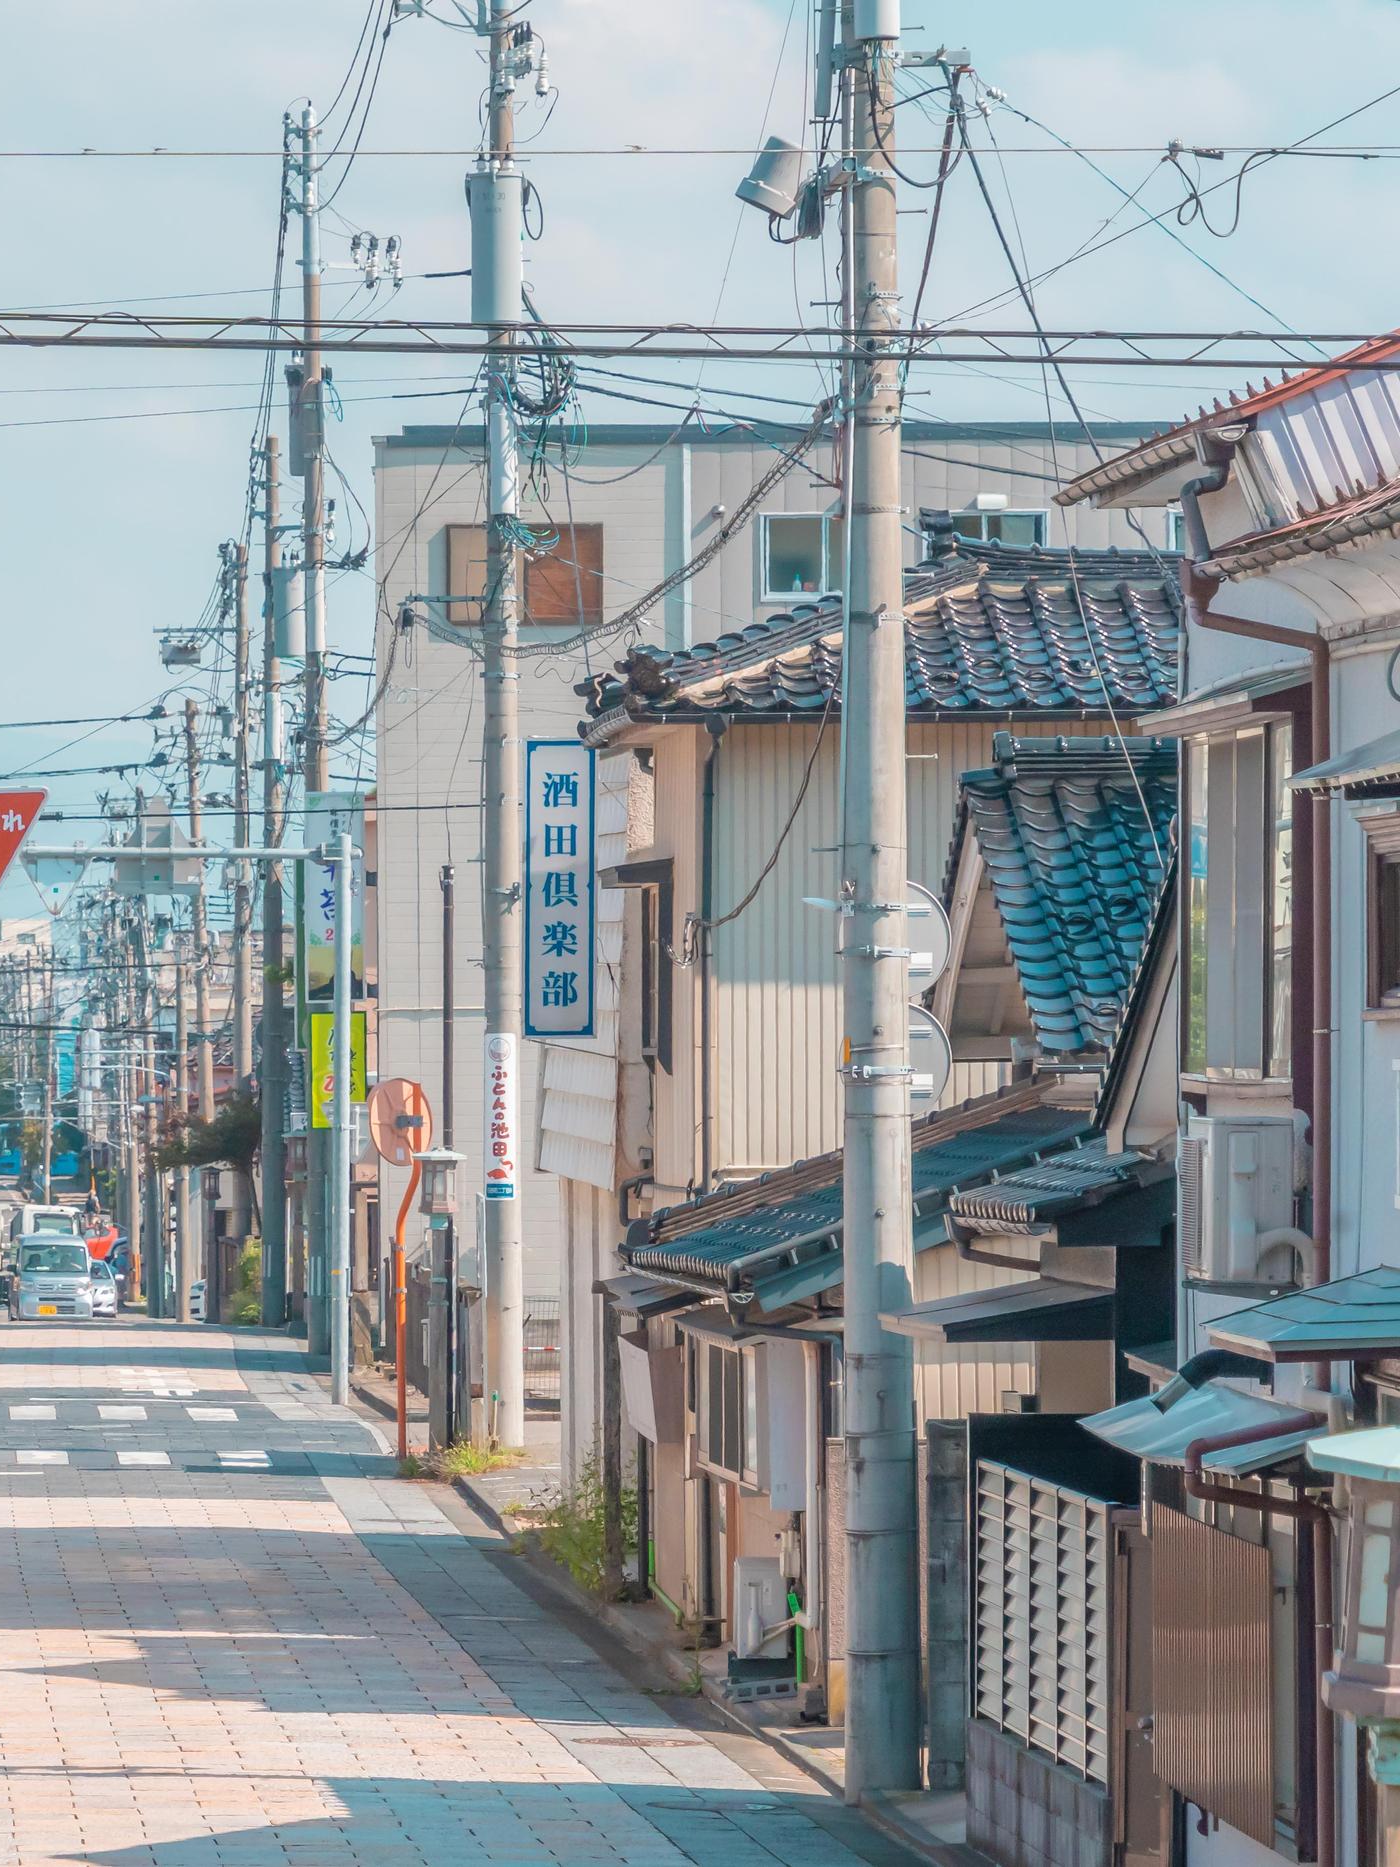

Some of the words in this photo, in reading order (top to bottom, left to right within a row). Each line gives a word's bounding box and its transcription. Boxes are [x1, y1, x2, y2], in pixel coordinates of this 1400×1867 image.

[542, 772, 579, 1008] 酒田倶楽部
[491, 1066, 510, 1157] ふとんの池田
